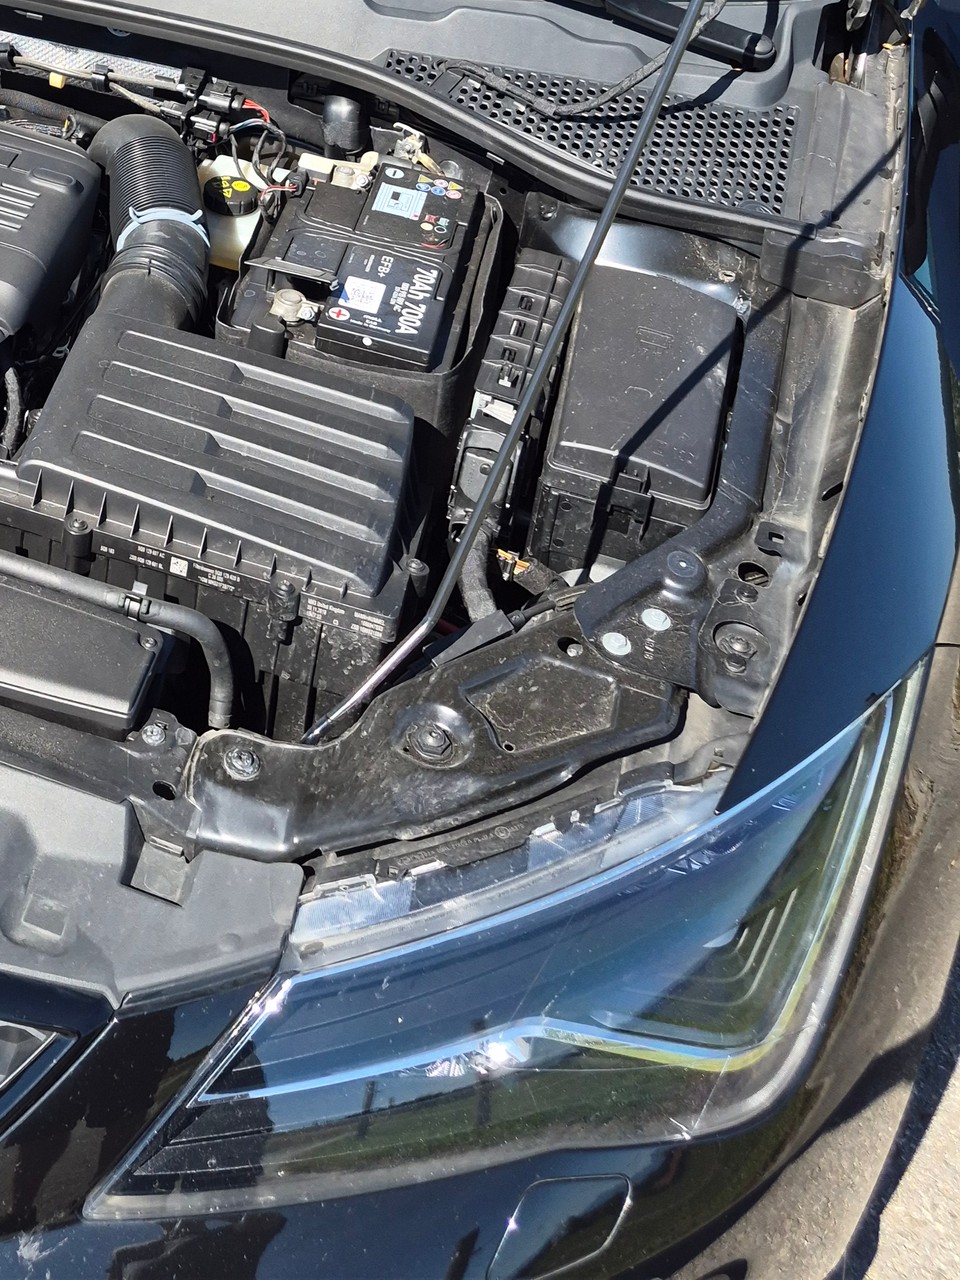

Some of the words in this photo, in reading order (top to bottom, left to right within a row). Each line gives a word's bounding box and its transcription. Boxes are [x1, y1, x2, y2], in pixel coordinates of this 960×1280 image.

[378, 255, 394, 278] EFB+
[407, 267, 439, 301] 70Ah
[394, 301, 427, 335] 700A
